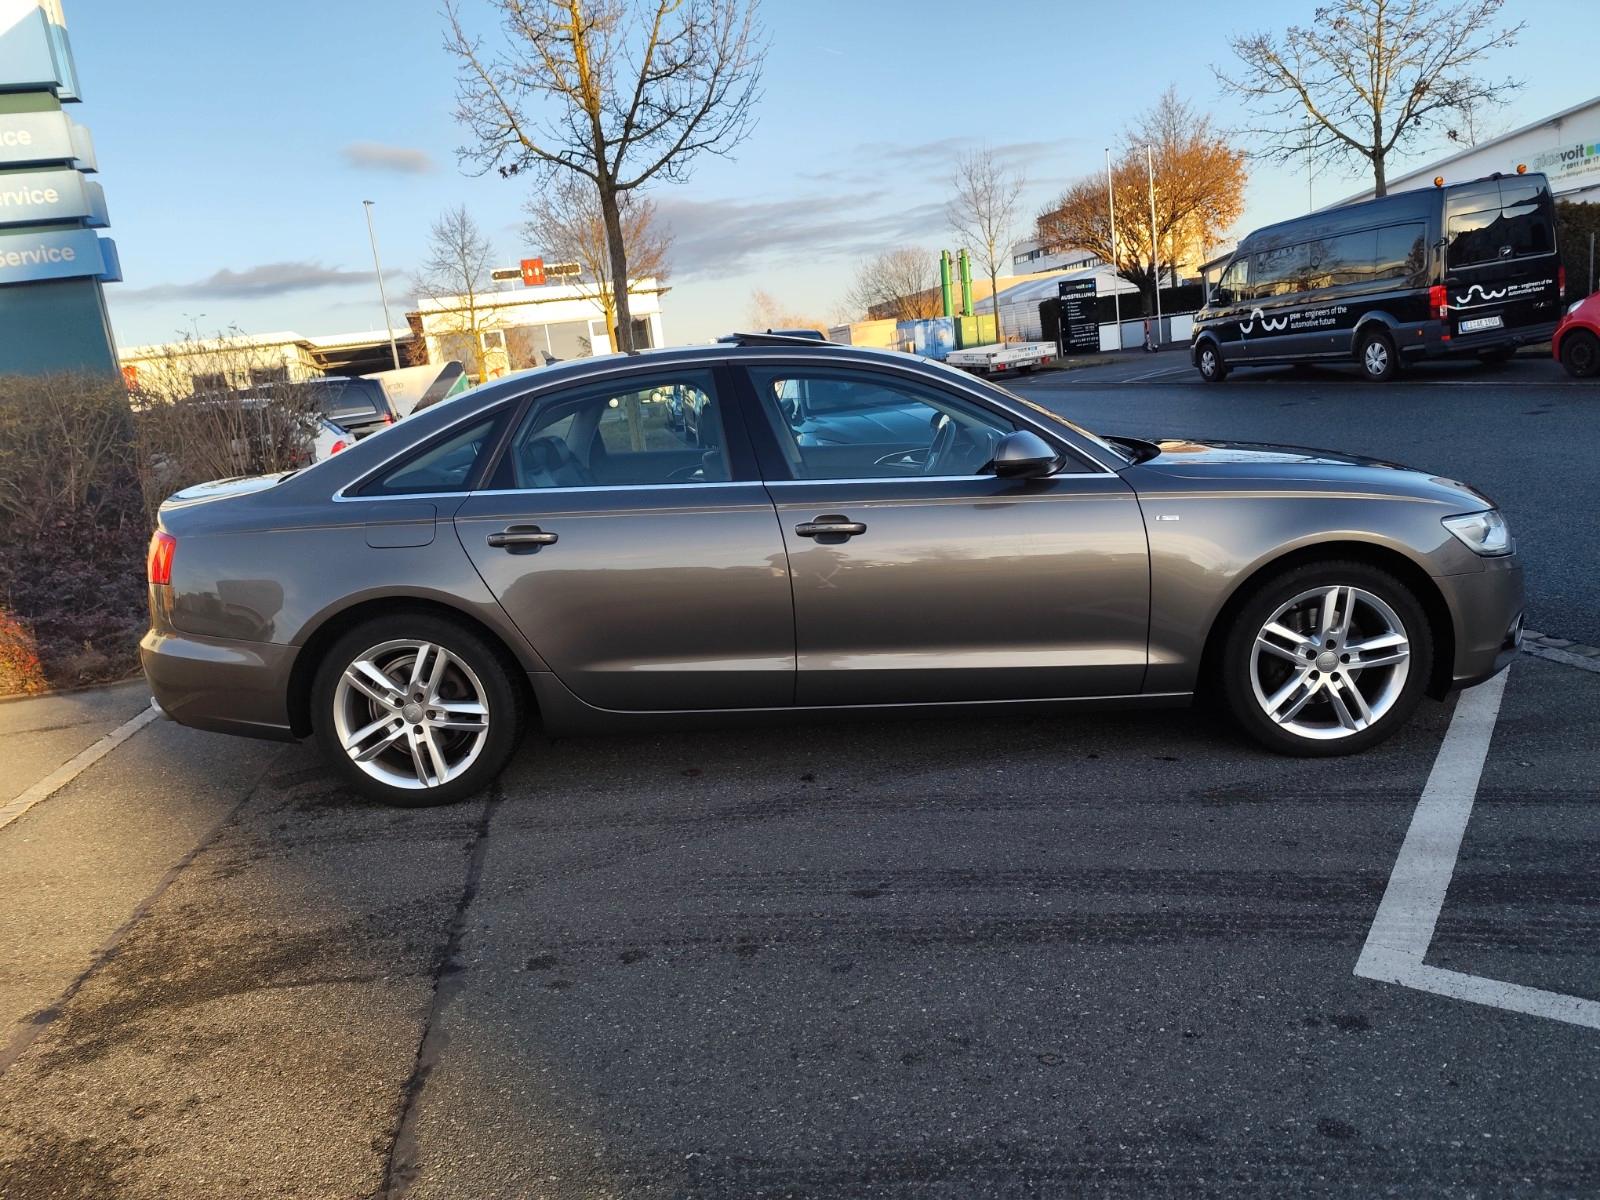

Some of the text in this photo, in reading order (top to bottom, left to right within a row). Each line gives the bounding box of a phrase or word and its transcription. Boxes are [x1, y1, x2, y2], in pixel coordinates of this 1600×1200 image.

[1061, 291, 1095, 301] AUSSTELLUNG
[1305, 309, 1330, 320] engineers
[1331, 306, 1337, 314] of
[1291, 320, 1318, 328] automotive
